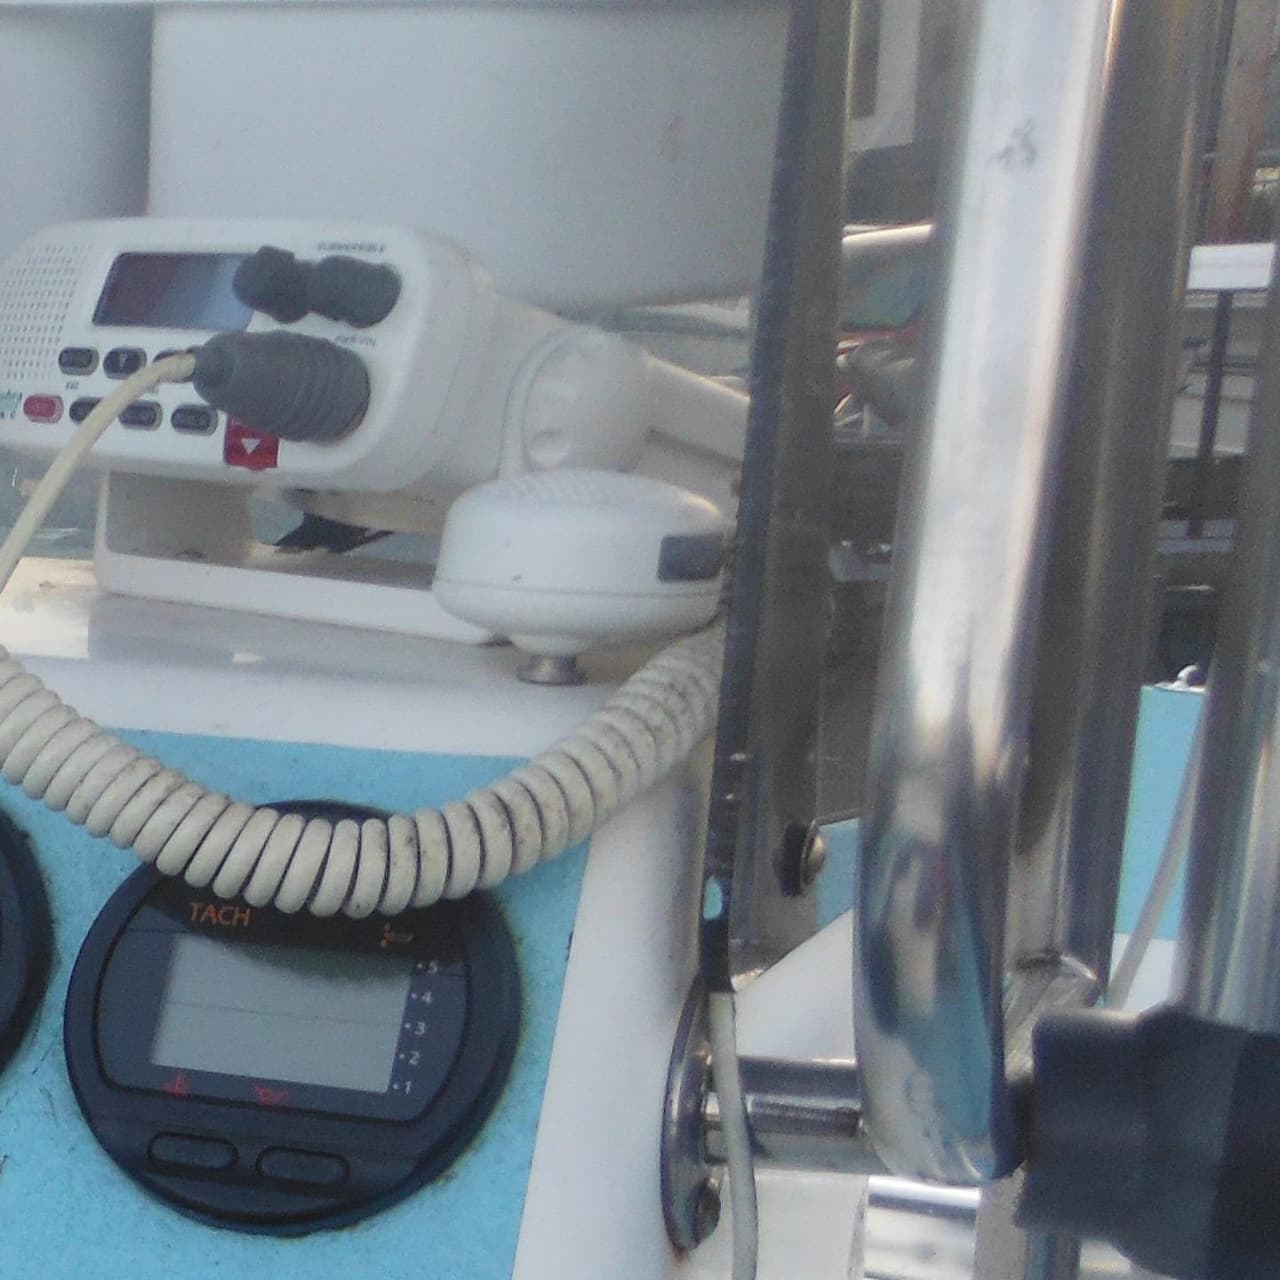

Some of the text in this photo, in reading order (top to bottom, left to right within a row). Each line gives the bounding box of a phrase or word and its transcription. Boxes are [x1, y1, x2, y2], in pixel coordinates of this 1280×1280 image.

[189, 901, 251, 927] TACH
[427, 960, 439, 974] 5
[421, 991, 433, 1004] 4
[414, 1021, 426, 1036] 3
[408, 1051, 421, 1066] 2
[404, 1080, 413, 1095] 1
